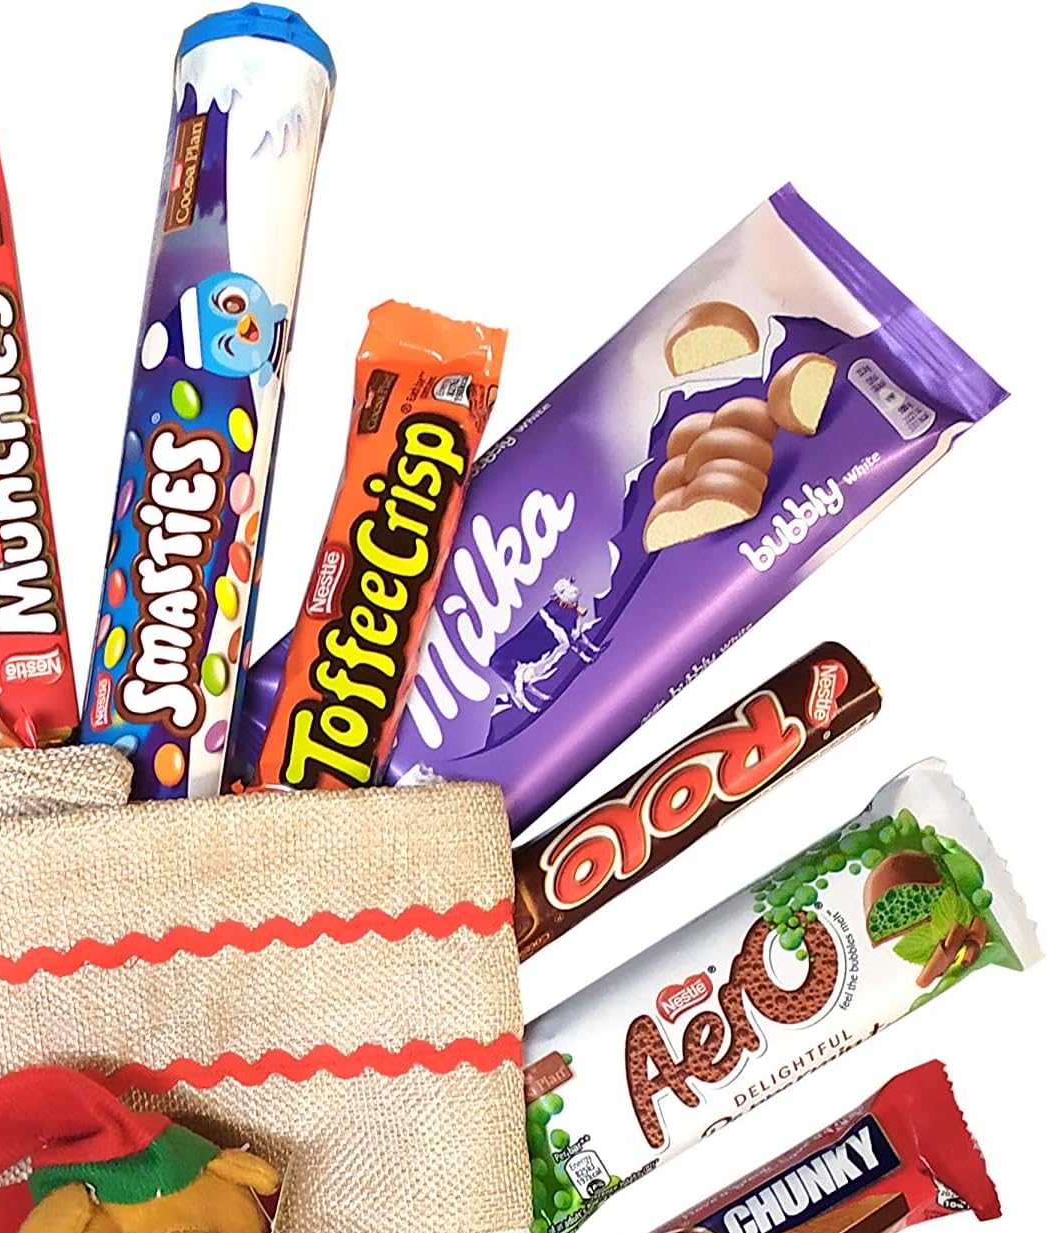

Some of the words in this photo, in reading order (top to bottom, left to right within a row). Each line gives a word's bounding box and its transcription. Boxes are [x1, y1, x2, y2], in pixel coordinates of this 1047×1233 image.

[184, 120, 204, 163] Plan
[175, 163, 198, 224] Cocoa
[738, 475, 844, 572] bubbly
[406, 488, 576, 750] Milka
[544, 691, 804, 908] Rolo
[831, 911, 849, 932] melt
[843, 932, 860, 971] bubbles
[838, 991, 853, 1010] feel
[846, 974, 858, 990] the
[625, 911, 839, 1151] Aero
[733, 1029, 853, 1108] DELIGHTFUL
